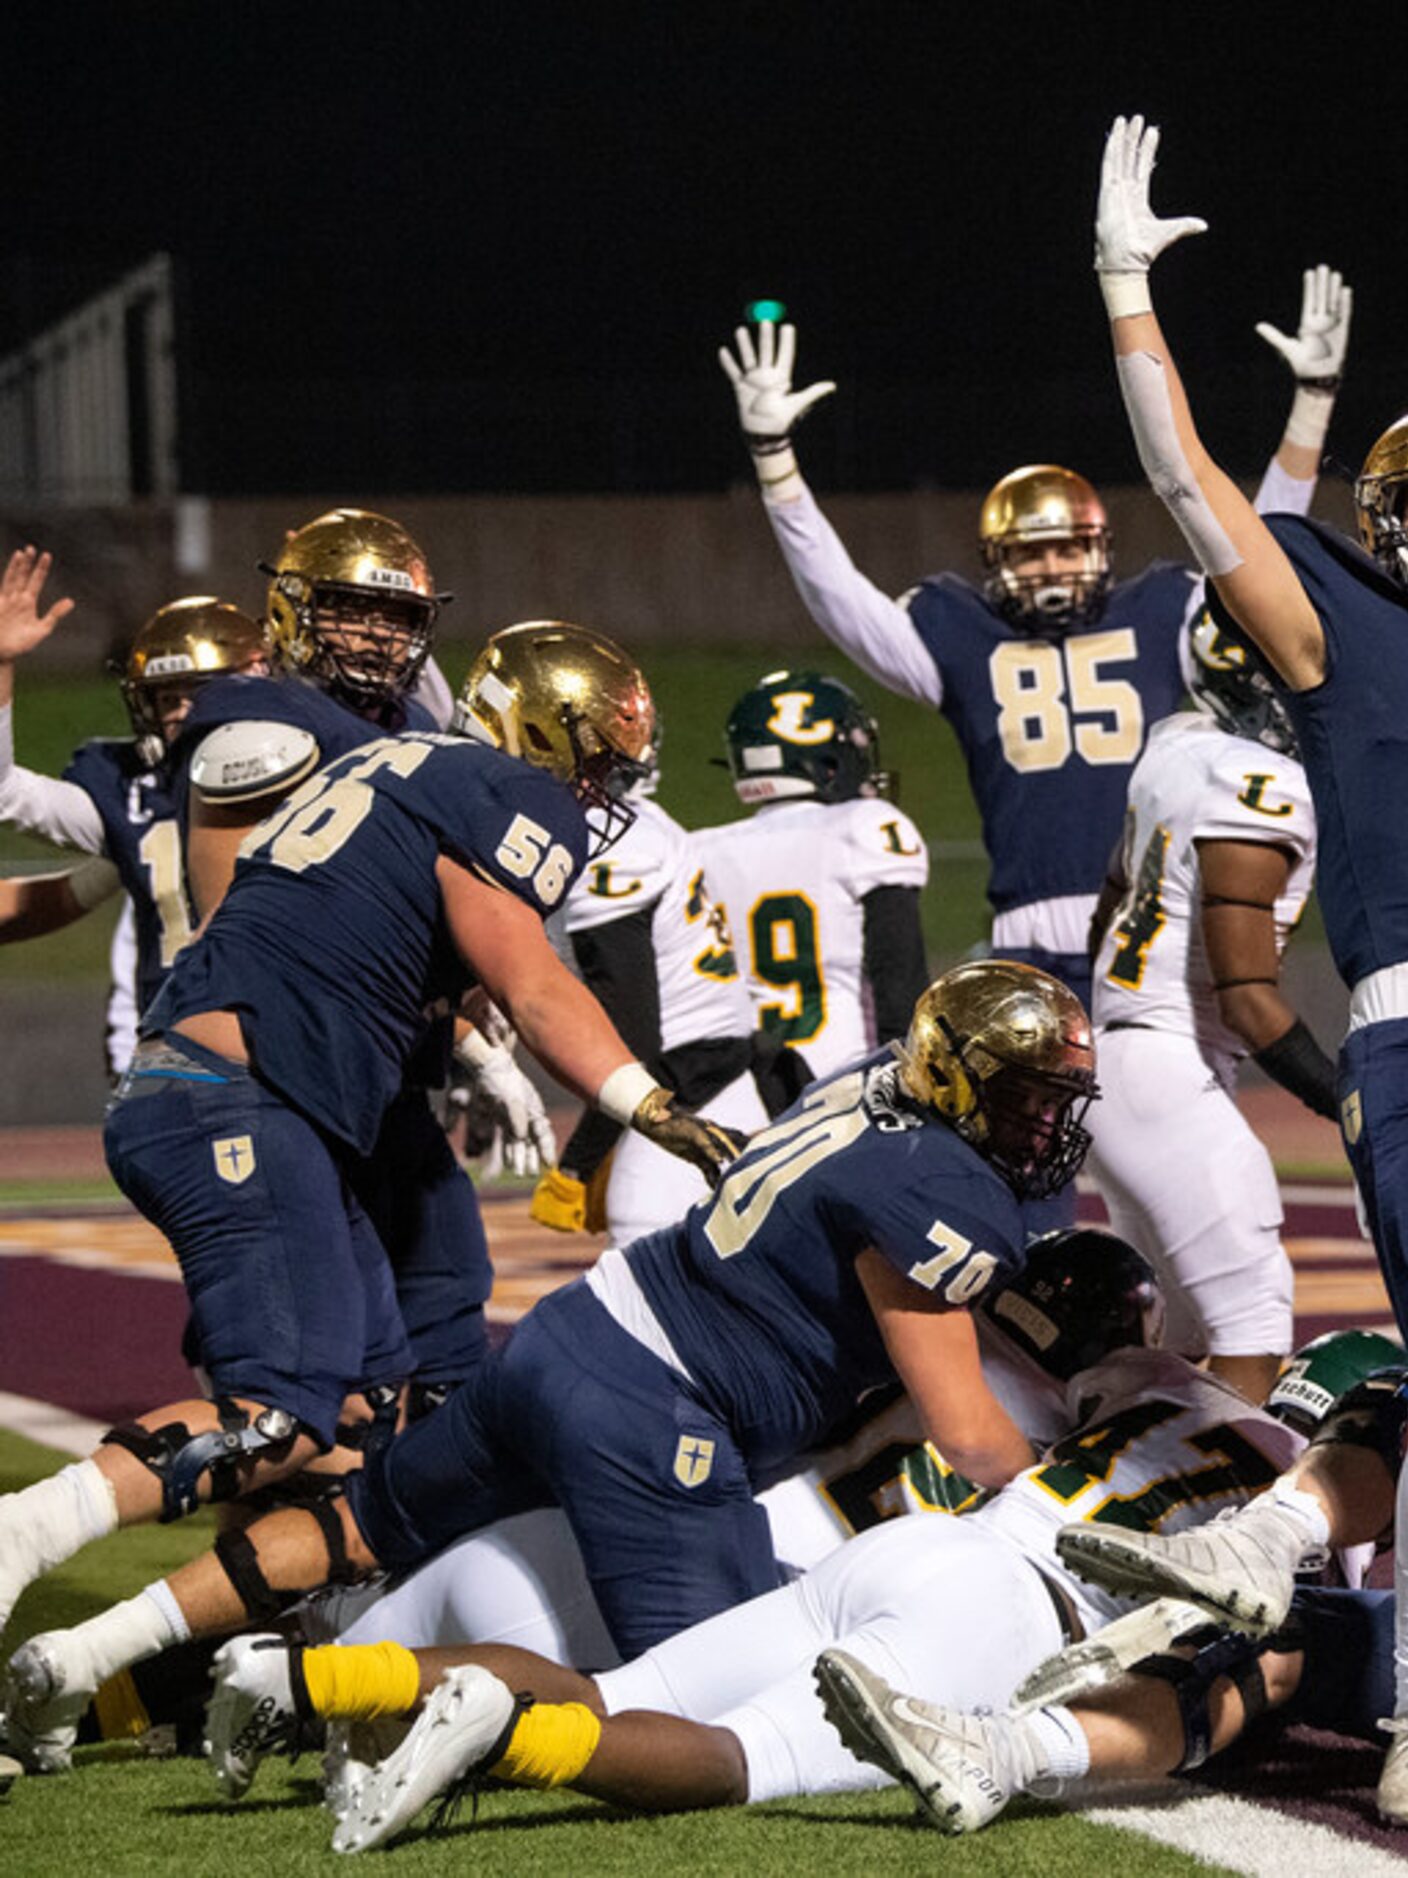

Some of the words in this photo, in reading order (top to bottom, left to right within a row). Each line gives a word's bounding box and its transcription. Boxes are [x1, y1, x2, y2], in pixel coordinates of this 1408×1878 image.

[766, 690, 835, 746] L
[989, 627, 1144, 774] 85
[128, 774, 157, 824] C
[1237, 773, 1293, 817] L
[494, 811, 575, 906] 56
[879, 820, 922, 857] L
[587, 860, 642, 898] L
[747, 888, 829, 1048] 9
[704, 1070, 870, 1260] 70
[908, 1219, 999, 1305] 70
[1279, 1381, 1330, 1410] schutt
